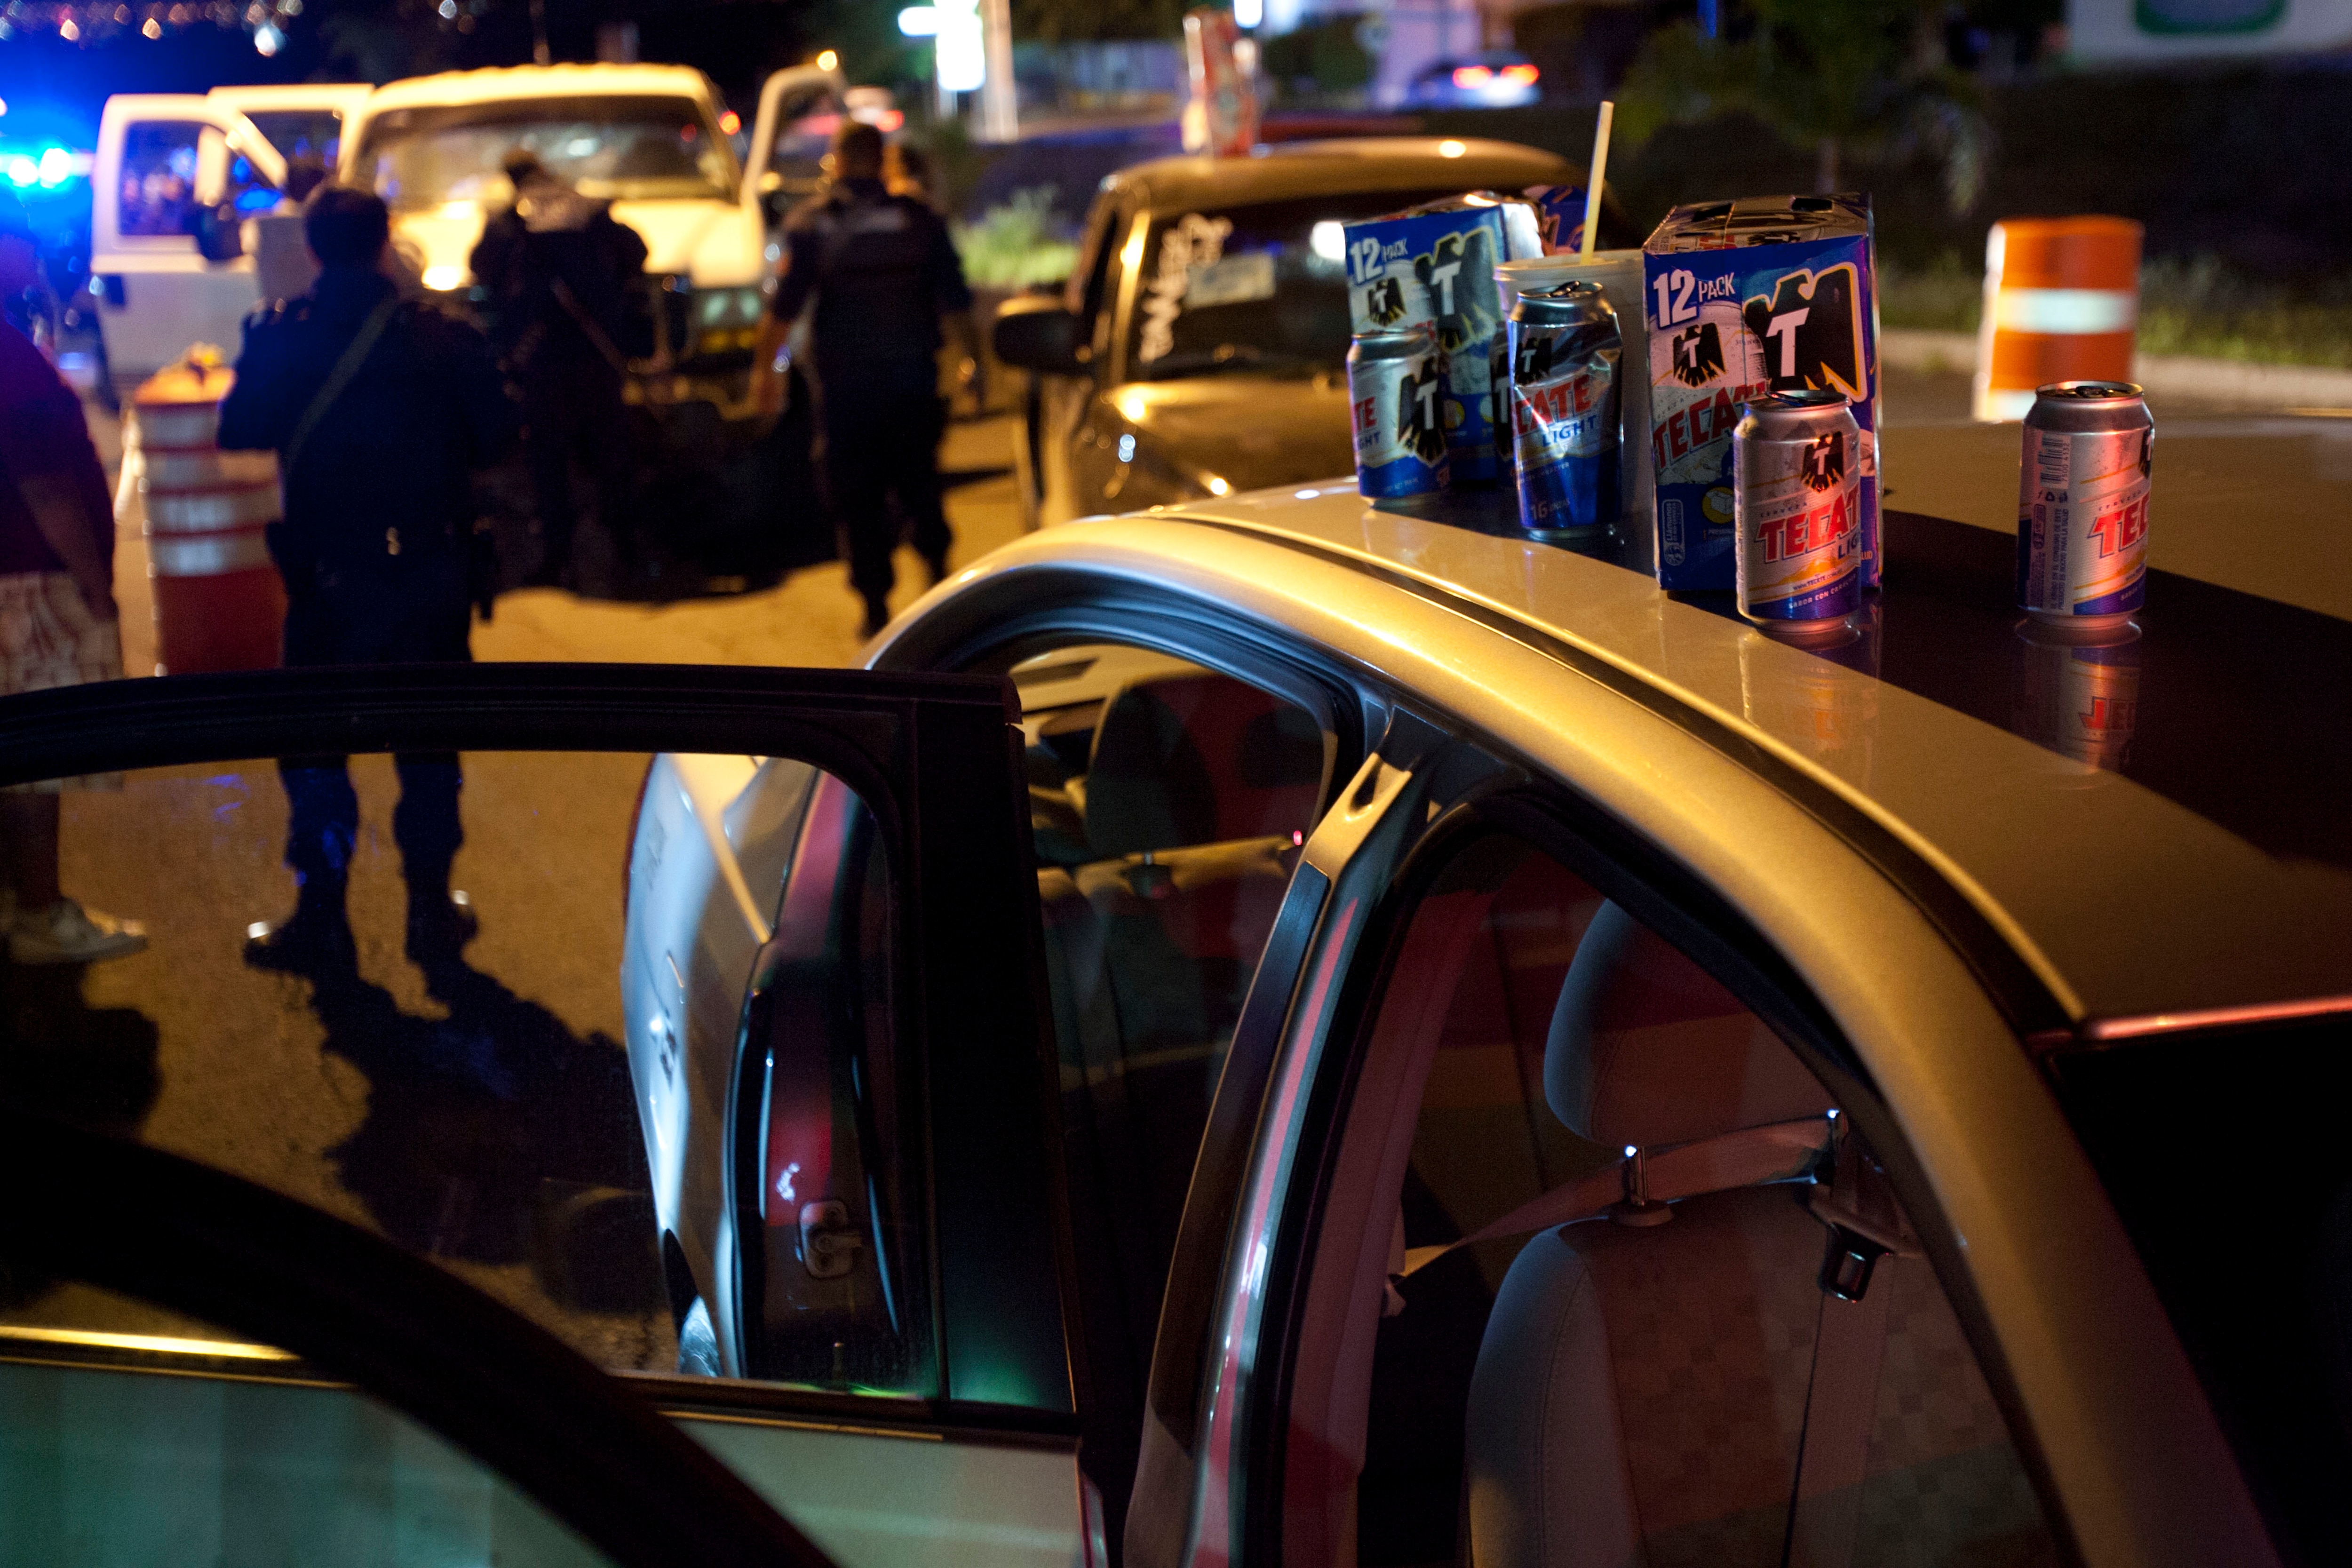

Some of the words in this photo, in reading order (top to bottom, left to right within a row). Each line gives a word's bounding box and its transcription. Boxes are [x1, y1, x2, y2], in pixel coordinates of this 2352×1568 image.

[1350, 237, 1383, 283] 12
[1382, 239, 1408, 262] PACK
[1374, 288, 1388, 313] T
[1430, 261, 1461, 315] T
[1653, 269, 1697, 328] 12
[1699, 271, 1736, 302] PACK
[1682, 336, 1701, 368] T
[1766, 307, 1810, 377] T
[1520, 349, 1537, 373] T
[1415, 378, 1438, 430] T
[1542, 414, 1597, 446] LIGHT
[1813, 446, 1831, 475] T
[1760, 502, 1807, 518] CERVEZA
[1815, 591, 1829, 600] CON
